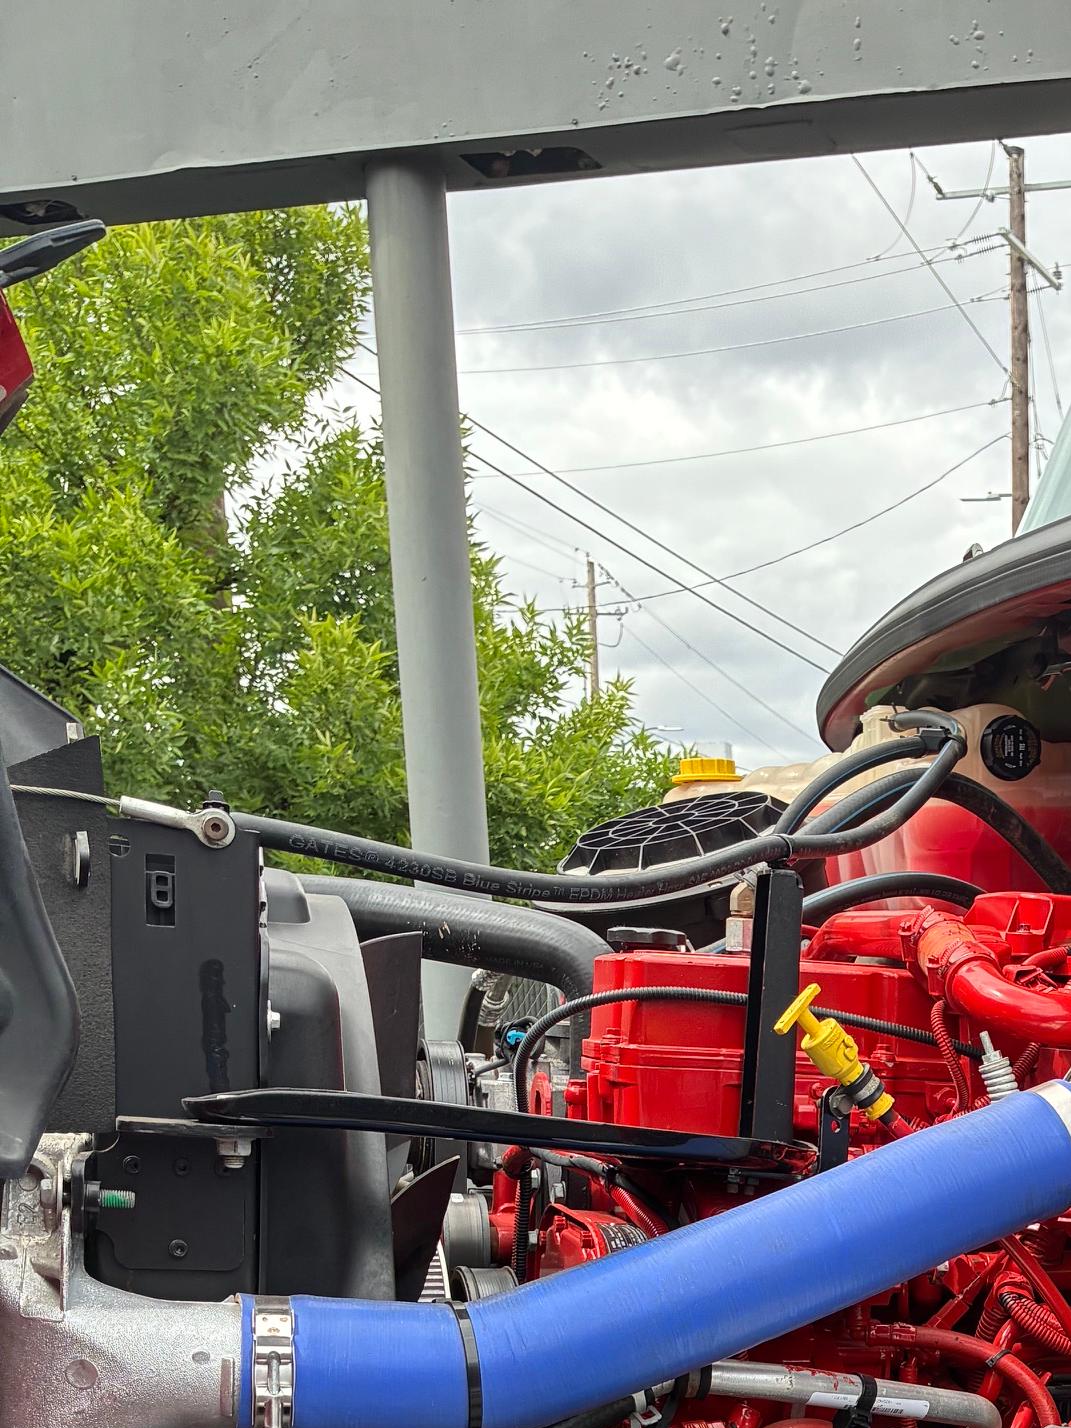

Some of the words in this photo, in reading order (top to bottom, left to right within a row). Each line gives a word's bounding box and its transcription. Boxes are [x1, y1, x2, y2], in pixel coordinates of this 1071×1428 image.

[385, 855, 458, 883] 4230SB
[462, 871, 500, 890] Blue
[569, 887, 613, 901] EPDM
